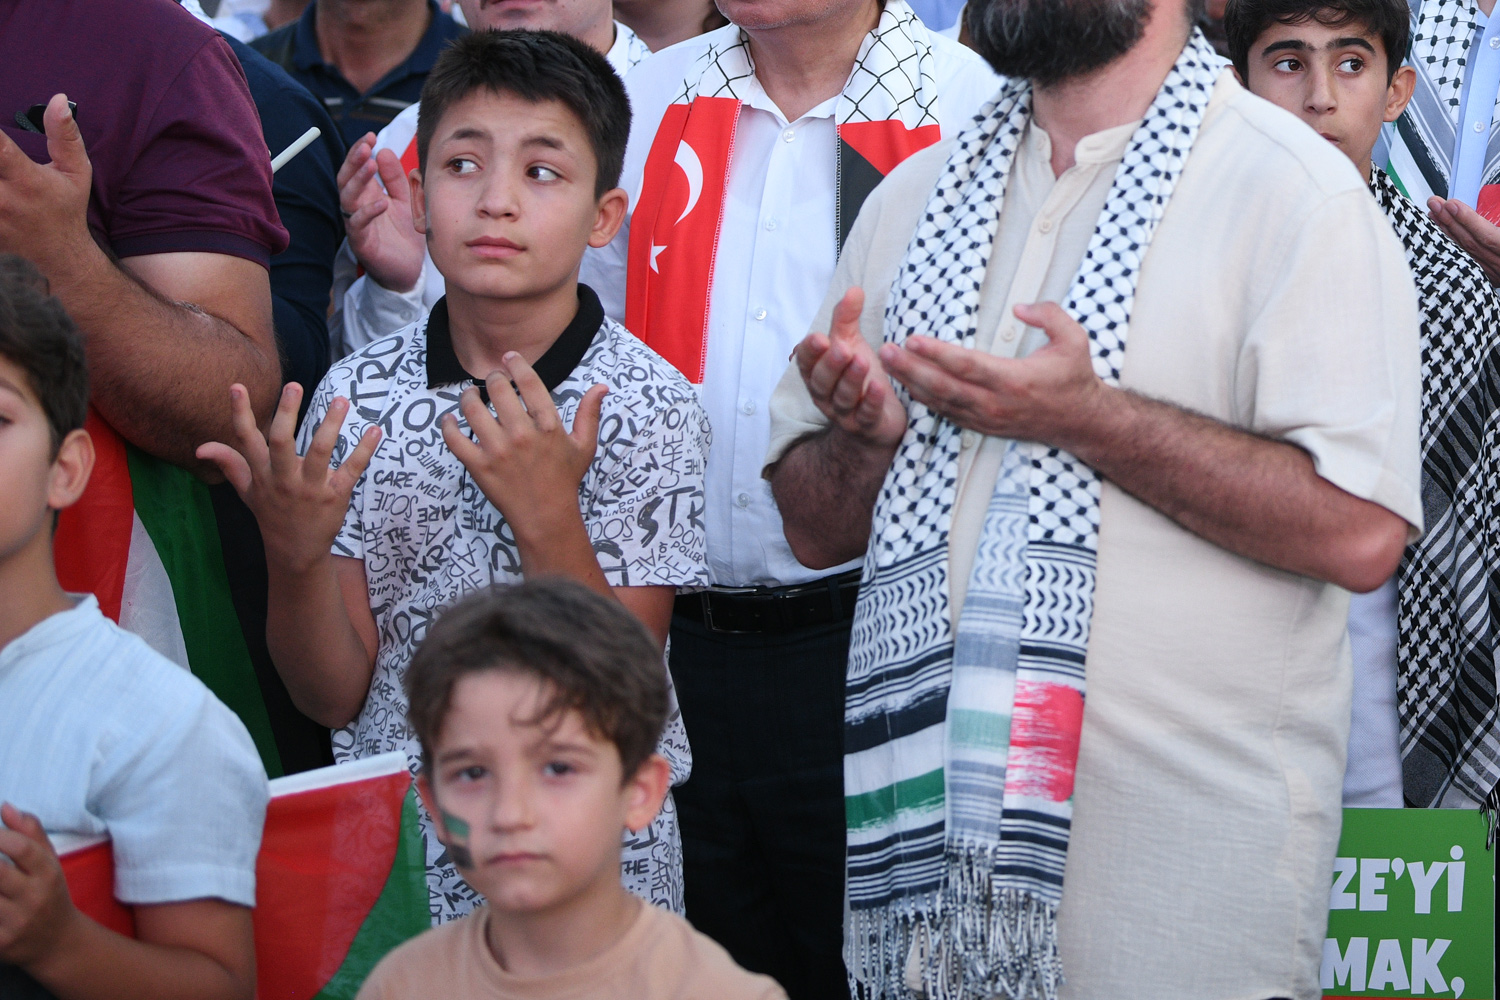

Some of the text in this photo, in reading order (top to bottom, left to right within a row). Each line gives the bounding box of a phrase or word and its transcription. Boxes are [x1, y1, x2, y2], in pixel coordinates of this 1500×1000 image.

[373, 469, 451, 500] CARE MEN
[1328, 844, 1466, 914] ZE’Yİ
[1318, 936, 1466, 999] MAK,
